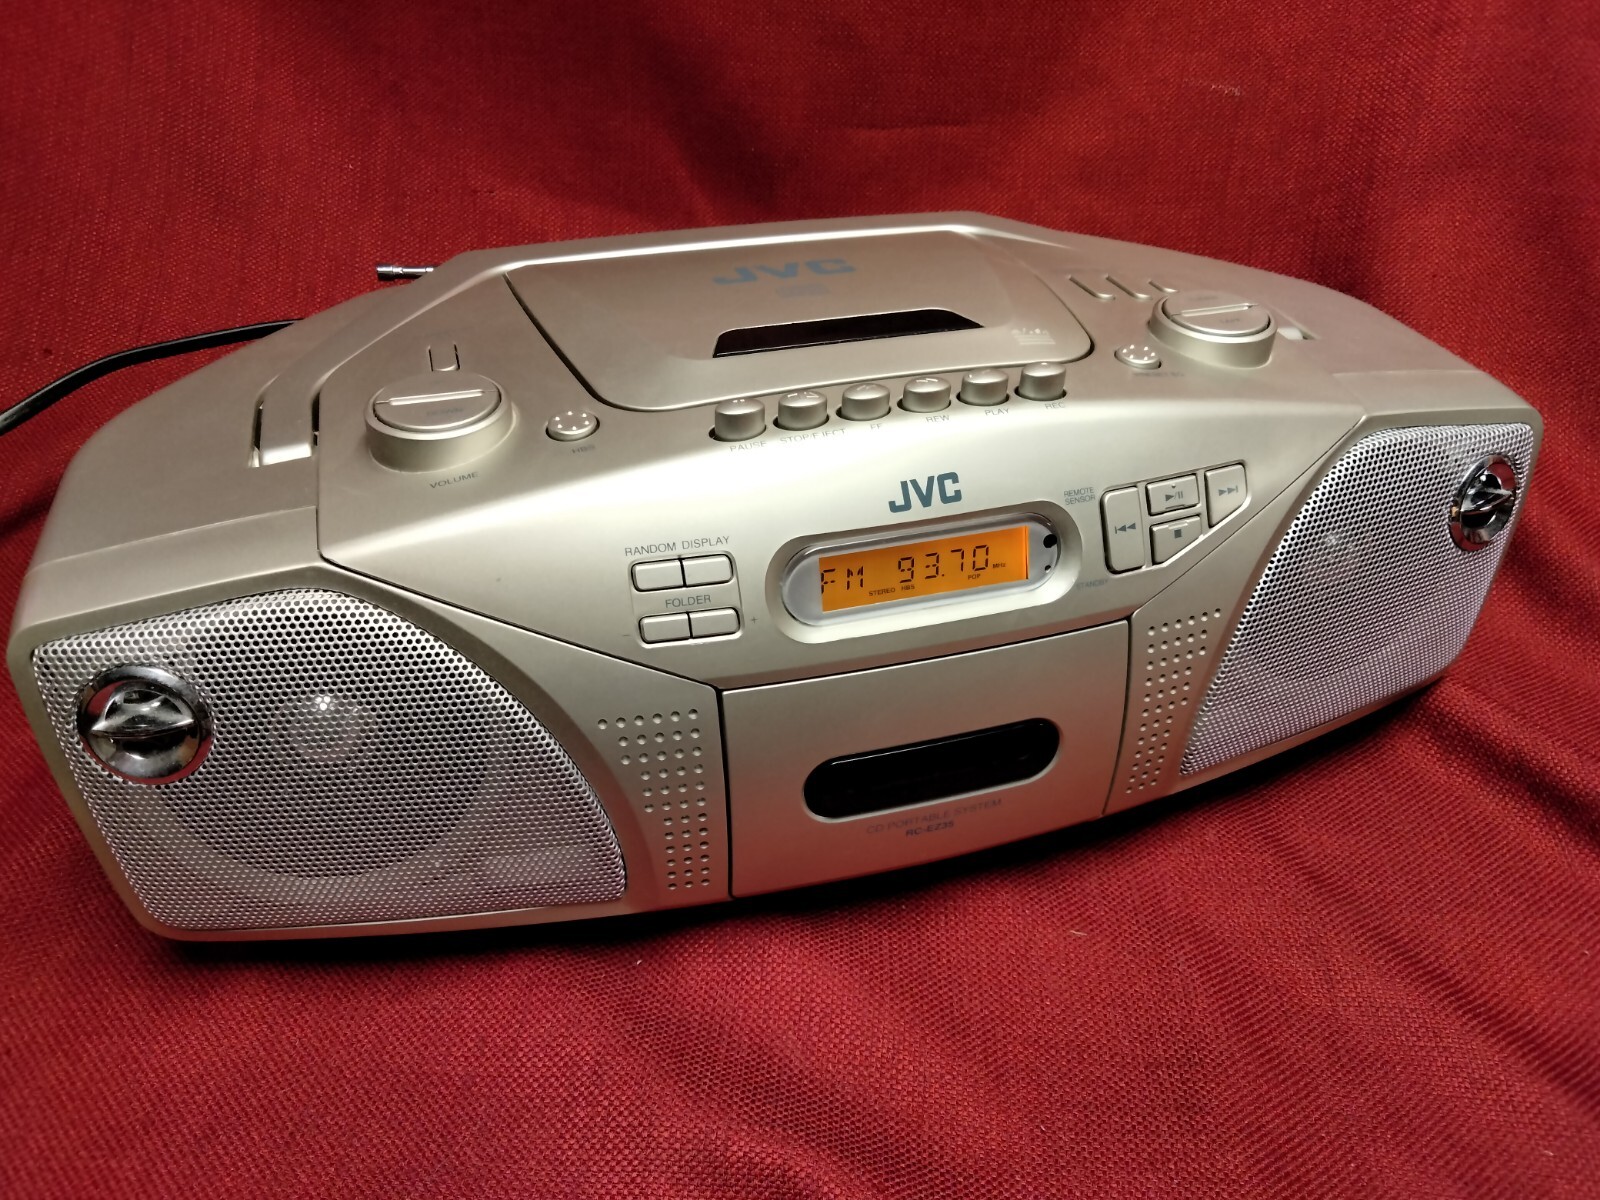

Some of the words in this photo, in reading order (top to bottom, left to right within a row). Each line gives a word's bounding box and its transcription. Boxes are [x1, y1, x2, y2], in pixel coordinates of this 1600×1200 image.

[712, 258, 856, 284] JVC
[984, 408, 1010, 417] PLAY
[1044, 401, 1066, 410] REC
[925, 414, 951, 424] REW
[729, 440, 767, 452] PAUSE
[429, 472, 478, 489] VOLUME
[888, 471, 962, 513] JVC
[1063, 486, 1095, 498] REMOTE
[1064, 494, 1096, 506] SENSOR
[624, 542, 677, 557] RANDOM
[681, 536, 730, 551] DISPLAY
[820, 565, 864, 595] FM
[897, 544, 990, 584] 93.70
[868, 587, 896, 597] STEREO
[901, 584, 916, 592] HBS
[664, 594, 712, 609] FOLDER
[866, 823, 885, 834] CD
[887, 810, 948, 831] PORTABLE
[953, 798, 1003, 816] SYSTEM
